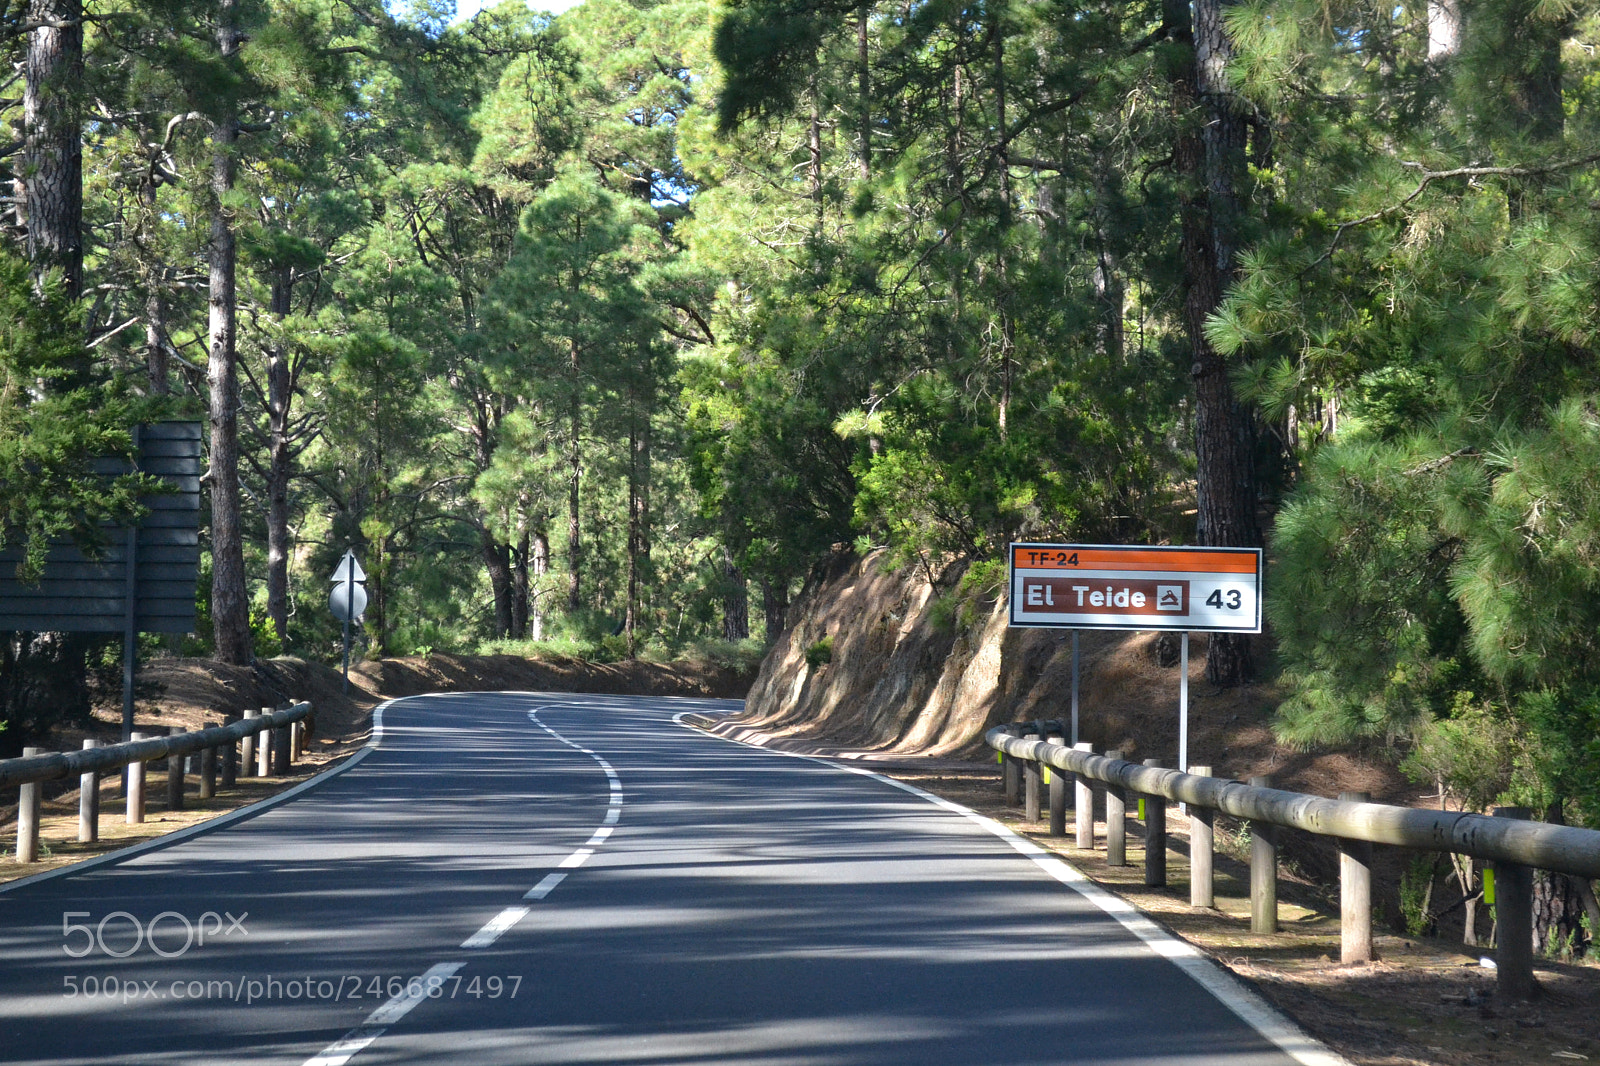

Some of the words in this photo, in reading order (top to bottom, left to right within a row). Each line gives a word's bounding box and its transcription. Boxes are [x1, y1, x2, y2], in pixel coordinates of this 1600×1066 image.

[1028, 552, 1079, 566] TF-24
[1027, 584, 1054, 606] El
[1072, 585, 1146, 608] Teide
[1205, 589, 1241, 610] 43
